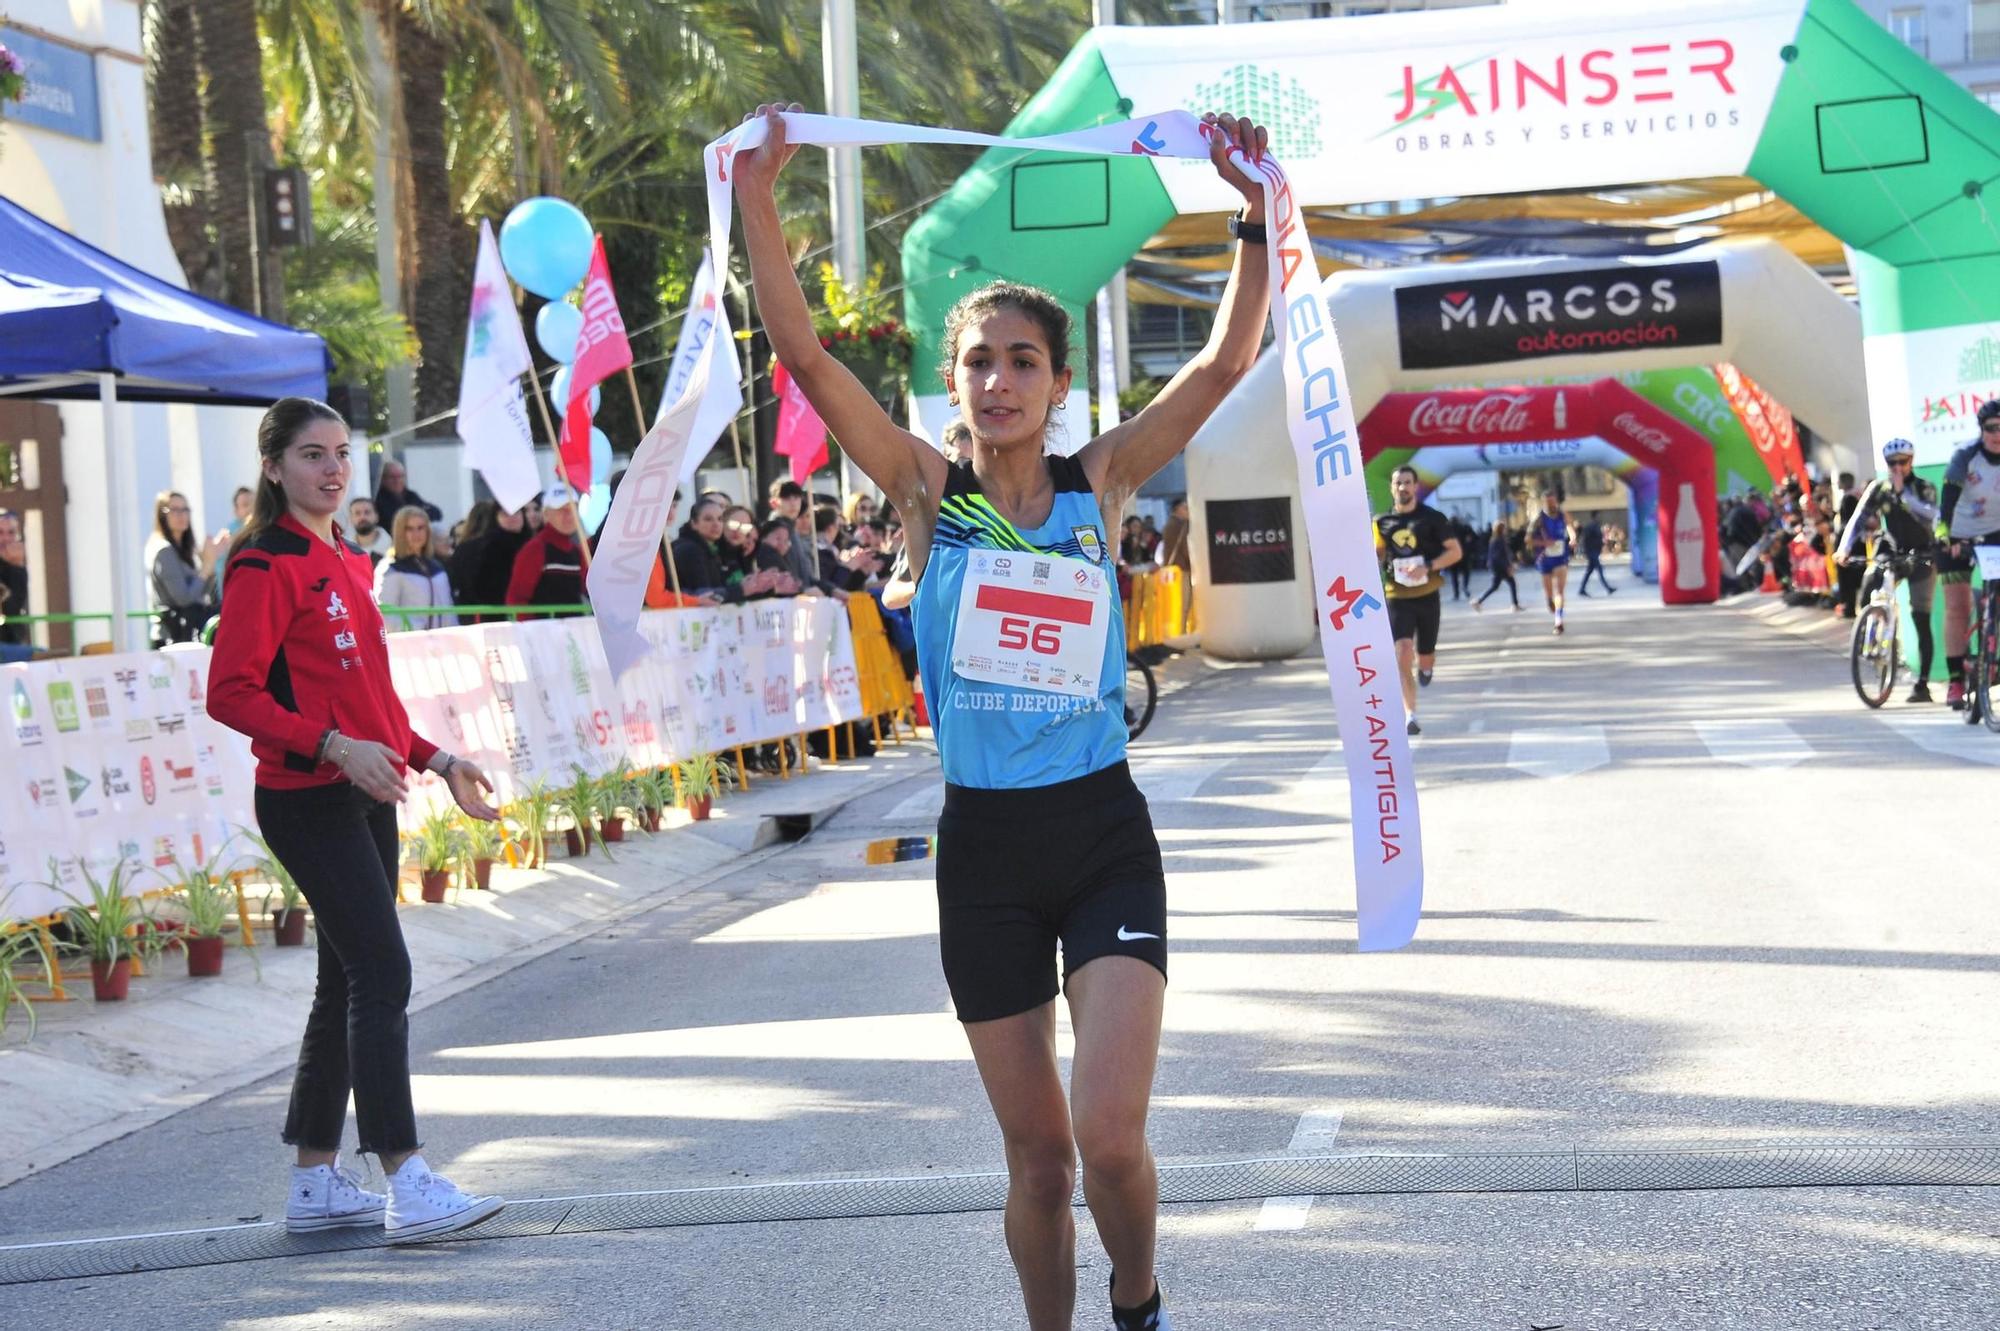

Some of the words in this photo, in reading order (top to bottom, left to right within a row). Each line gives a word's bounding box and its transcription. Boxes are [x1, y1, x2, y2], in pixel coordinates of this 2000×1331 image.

[1394, 38, 1736, 122] JAINSER
[1396, 130, 1496, 152] OBRAS
[1523, 126, 1534, 142] Y
[1560, 109, 1741, 138] SERVICIOS
[1254, 153, 1303, 295] EDIA
[1288, 293, 1352, 487] ELCHE
[1440, 278, 1677, 331] MARCOS
[1517, 320, 1678, 353] automoción
[1408, 393, 1535, 436] Coca-Cola
[1214, 528, 1287, 546] MARCOS
[998, 616, 1062, 656] 56
[953, 690, 1006, 712] CUBE
[1010, 691, 1108, 713] DEPORTA
[1352, 644, 1377, 688] LA
[1365, 715, 1401, 865] ANTIGUA
